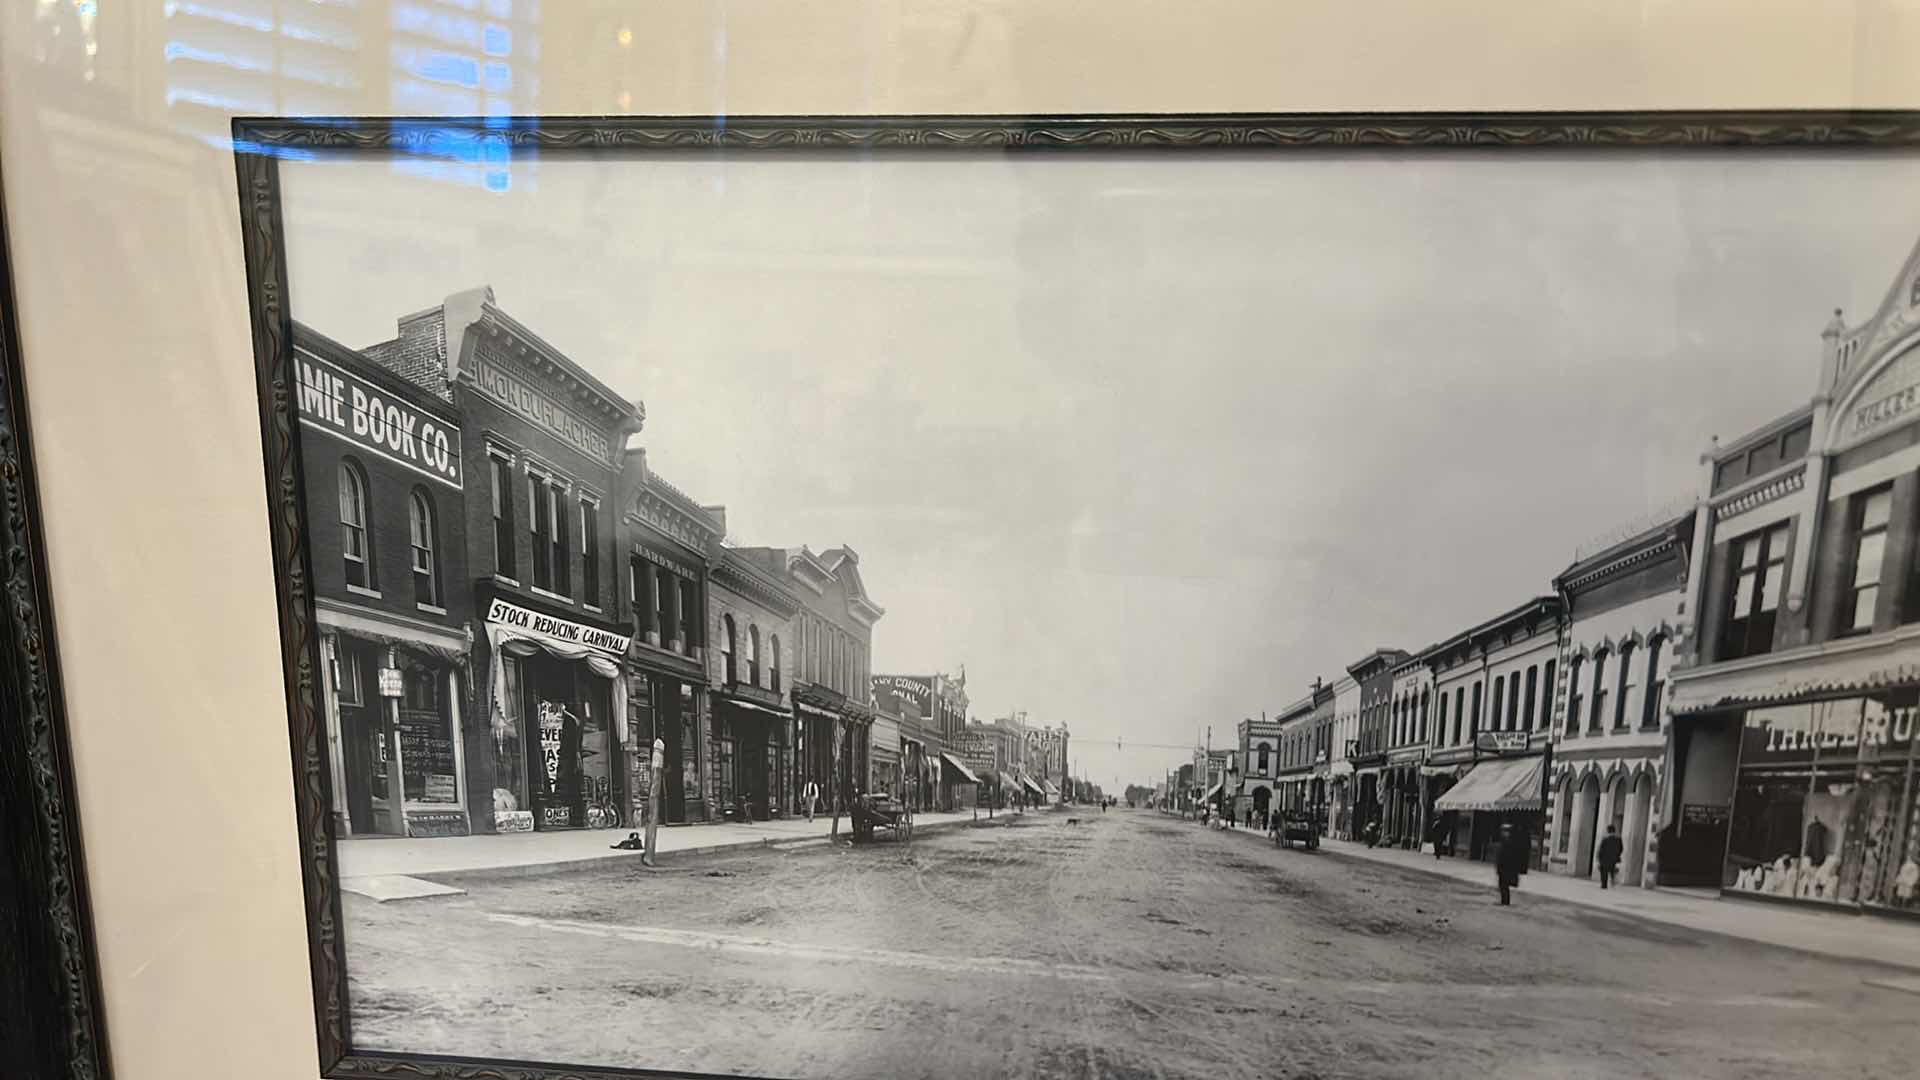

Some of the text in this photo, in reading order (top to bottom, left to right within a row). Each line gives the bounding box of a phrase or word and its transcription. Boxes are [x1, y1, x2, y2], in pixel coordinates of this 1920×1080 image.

[352, 386, 417, 460] BOOK
[421, 423, 456, 477] CO.
[635, 543, 697, 583] HARDWARE
[491, 603, 626, 652] STOCK REDUCING CARNIVAL
[895, 677, 931, 698] COUNTY
